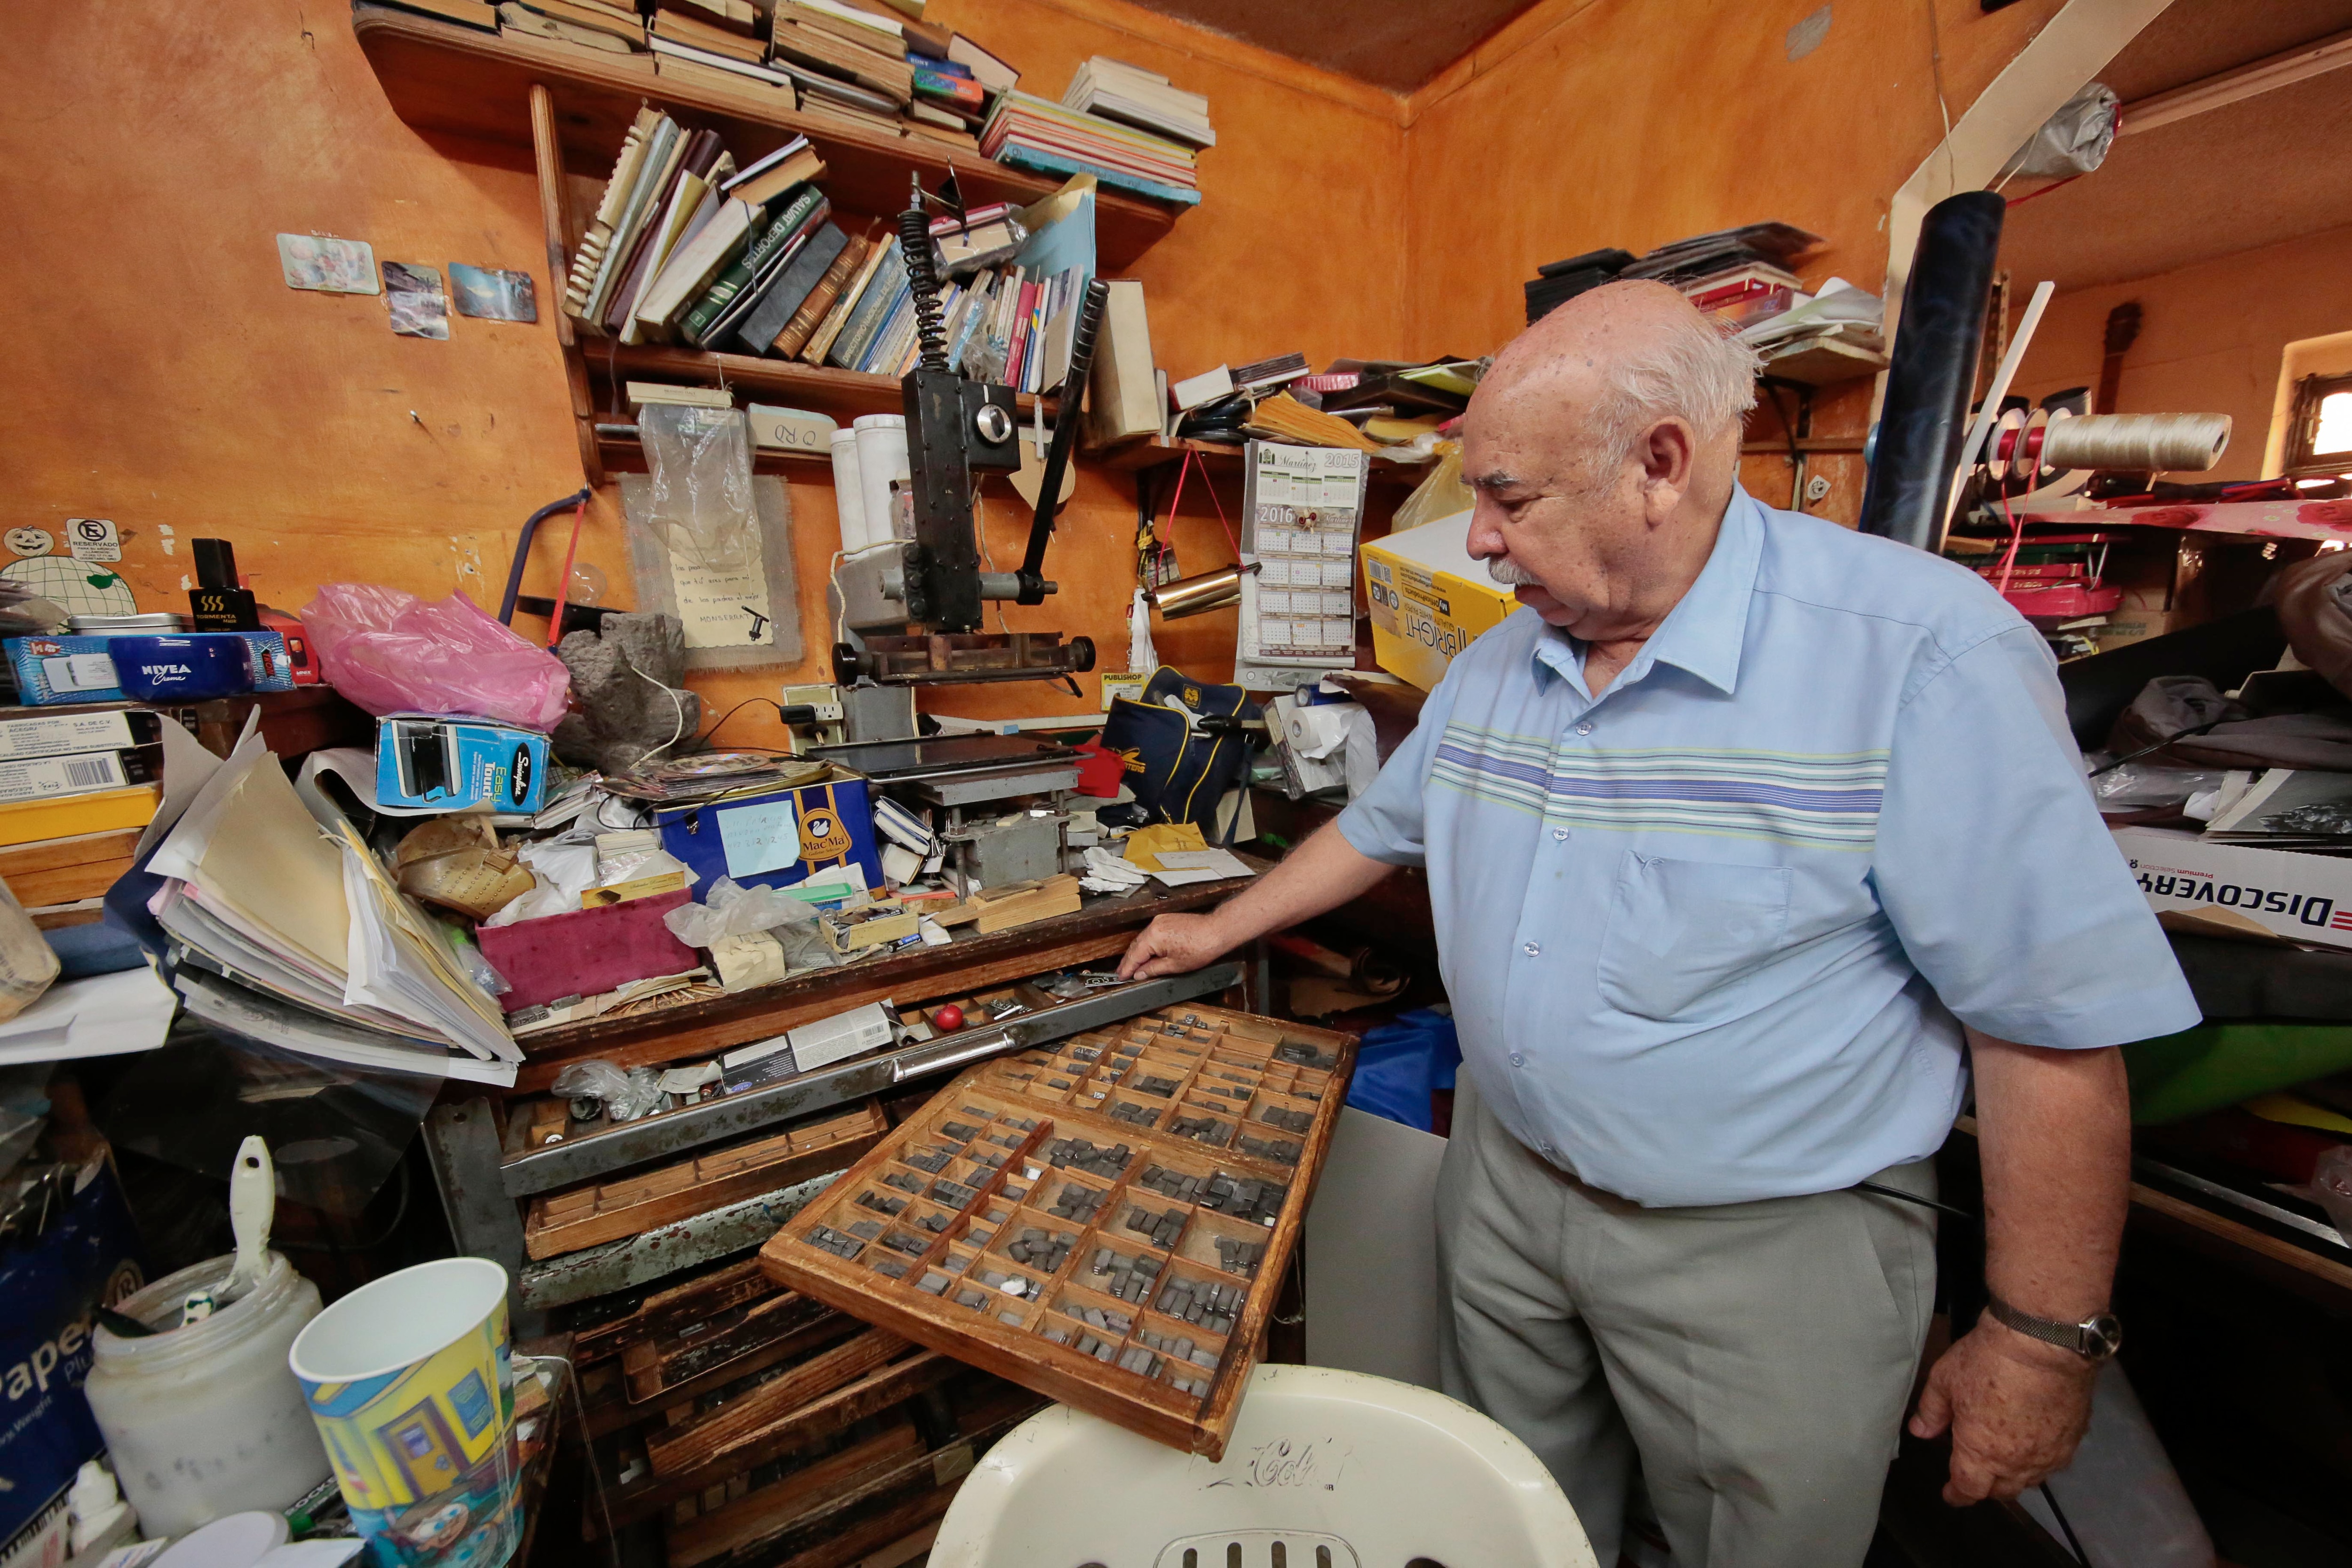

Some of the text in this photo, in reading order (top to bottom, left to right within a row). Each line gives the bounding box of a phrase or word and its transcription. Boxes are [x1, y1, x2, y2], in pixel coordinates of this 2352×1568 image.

[910, 57, 929, 67] SONY
[781, 194, 811, 227] SALVAT
[842, 324, 867, 364] DIRECTORIO
[865, 296, 883, 326] NACIONAL
[880, 284, 890, 298] DE
[1276, 452, 1360, 473] Martínez 2015
[1260, 506, 1294, 524] 2016
[713, 595, 734, 604] padres
[699, 613, 750, 623] MONSERRAT
[1403, 603, 1455, 631] QUALITY WHITE PAPER
[1405, 613, 1457, 659] BRIGHT
[142, 664, 192, 675] NIVEA
[152, 672, 186, 686] Creme
[482, 761, 496, 799] Touch
[515, 751, 529, 796] Swingline
[492, 766, 507, 803] Easy
[803, 836, 845, 852] Mac'Ma
[2140, 863, 2214, 879] Premium Selection
[2137, 872, 2334, 927] DISCOVERY
